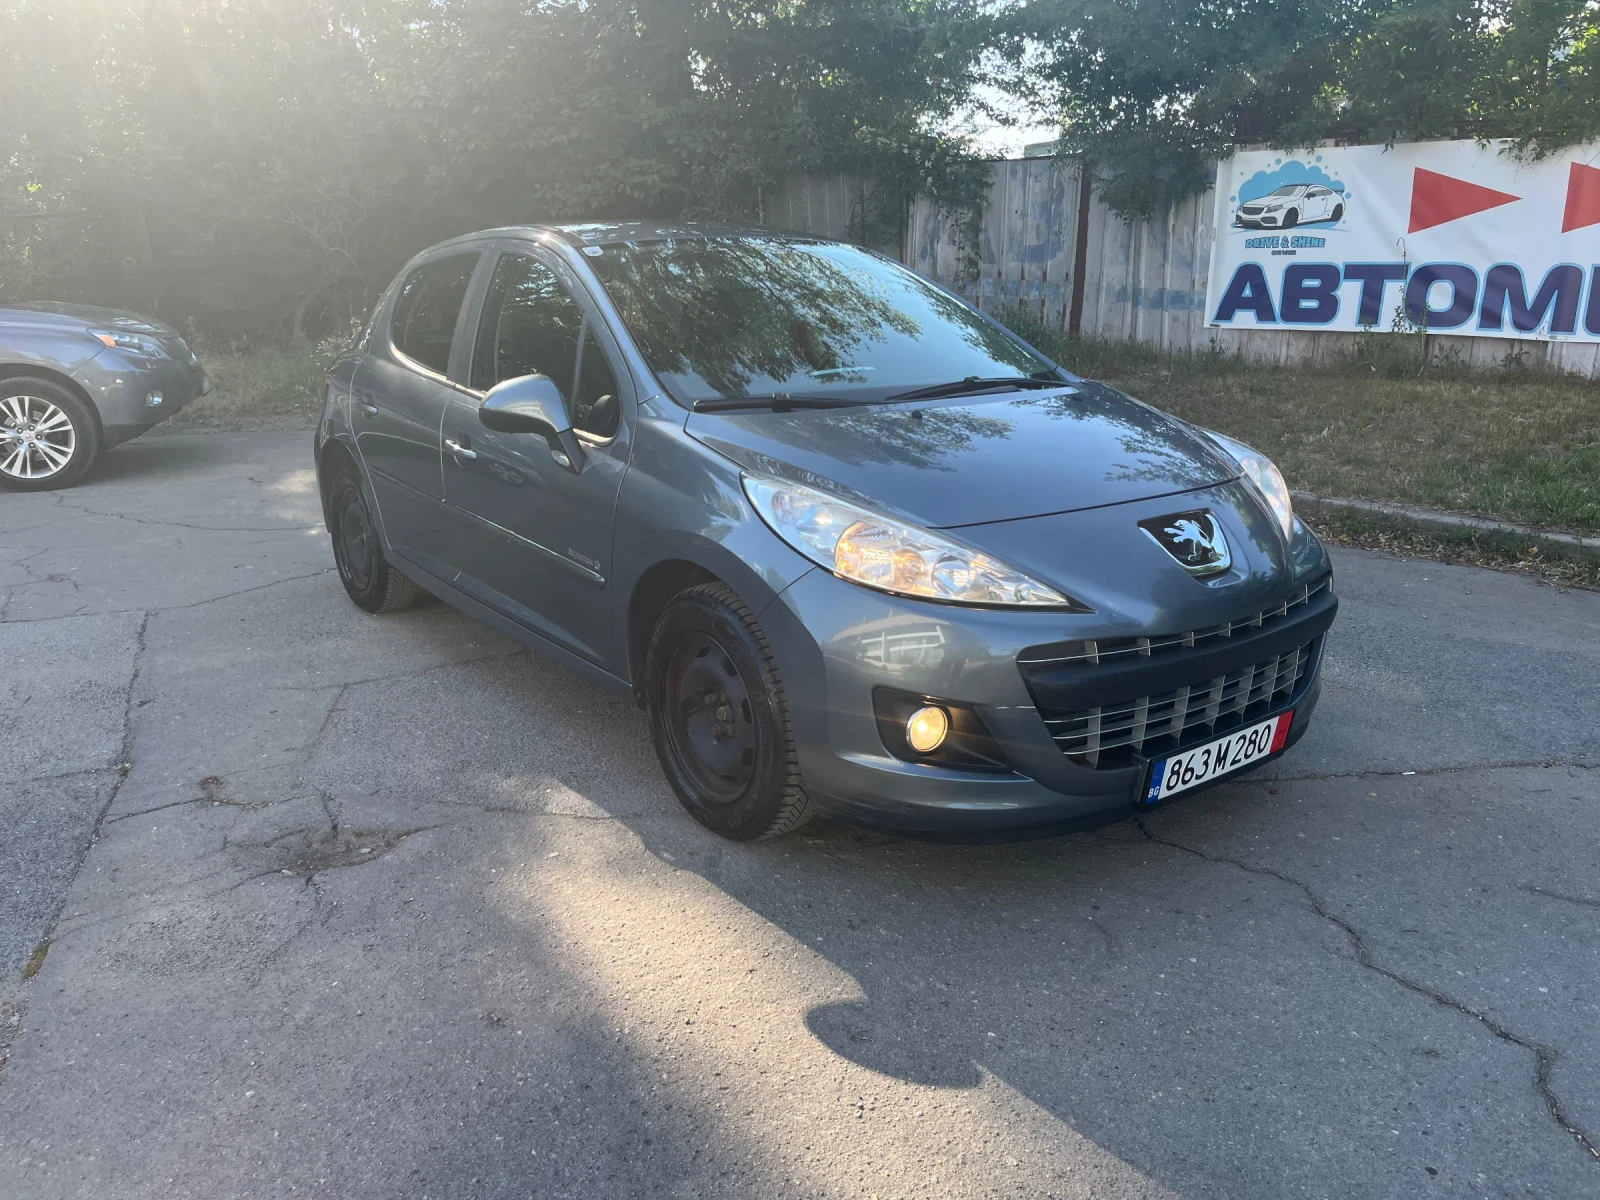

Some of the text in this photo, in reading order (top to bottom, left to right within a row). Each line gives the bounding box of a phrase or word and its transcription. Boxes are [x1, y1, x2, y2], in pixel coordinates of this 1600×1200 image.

[1245, 236, 1326, 248] DRIVE & SHINE
[1212, 262, 1600, 336] АВТОМ
[1148, 786, 1160, 798] BG
